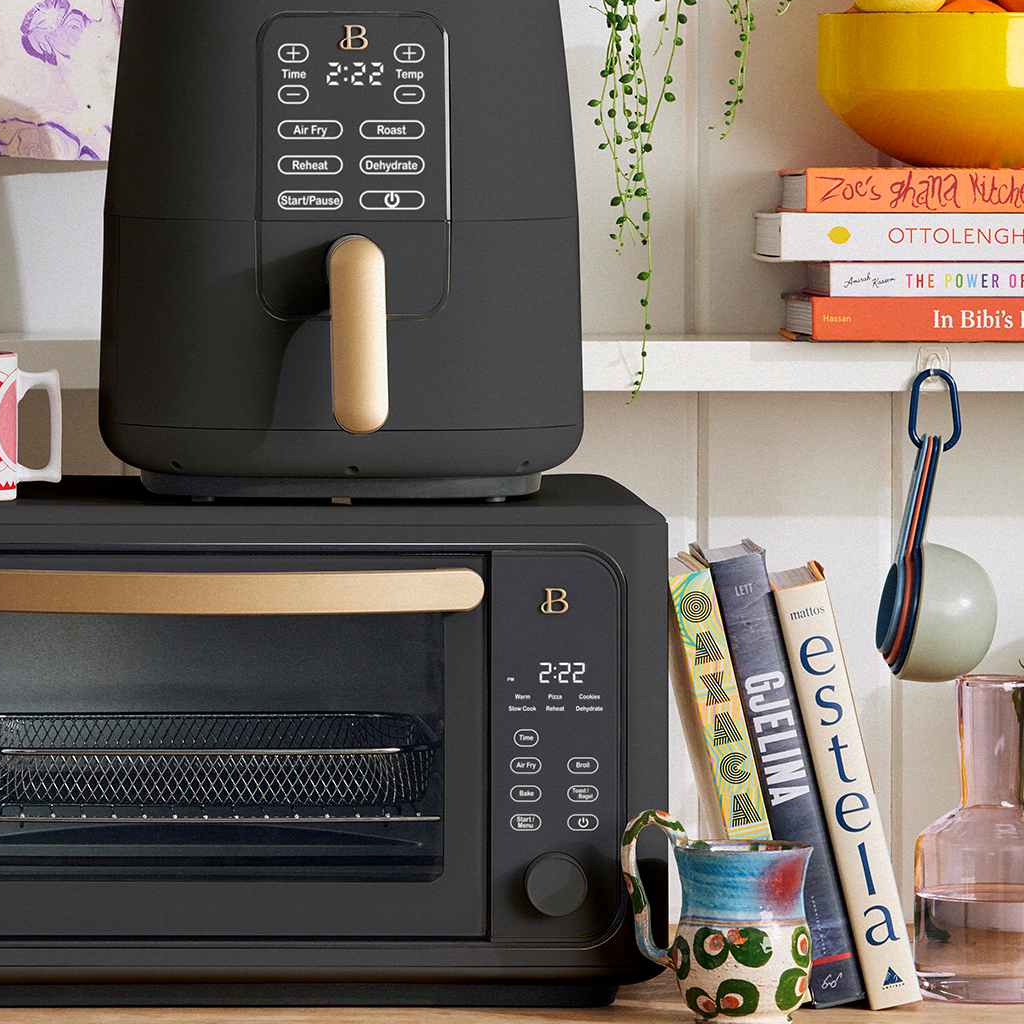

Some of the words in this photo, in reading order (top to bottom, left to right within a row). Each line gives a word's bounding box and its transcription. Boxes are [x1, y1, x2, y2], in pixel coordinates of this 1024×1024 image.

[338, 24, 369, 50] B
[282, 69, 306, 79] Time
[326, 62, 385, 86] 2:22
[396, 69, 424, 81] Temp
[293, 125, 309, 135] Air
[311, 125, 328, 137] Fry
[377, 125, 407, 136] Roast
[292, 160, 328, 170] Reheat
[365, 160, 418, 173] Dehydrate
[281, 195, 341, 206] Start/Pause
[888, 227, 1024, 244] OTTOLENGH
[906, 273, 935, 288] THE
[945, 273, 999, 288] POWER
[823, 314, 851, 323] Hassan
[933, 310, 954, 328] In
[961, 309, 1013, 329] Bibi's
[734, 583, 753, 597] LETT
[540, 587, 569, 614] B
[790, 606, 826, 621] mattos
[539, 662, 585, 684] 2:22
[744, 670, 811, 808] GJELINA
[526, 762, 536, 770] Fry
[799, 635, 901, 947] estela
